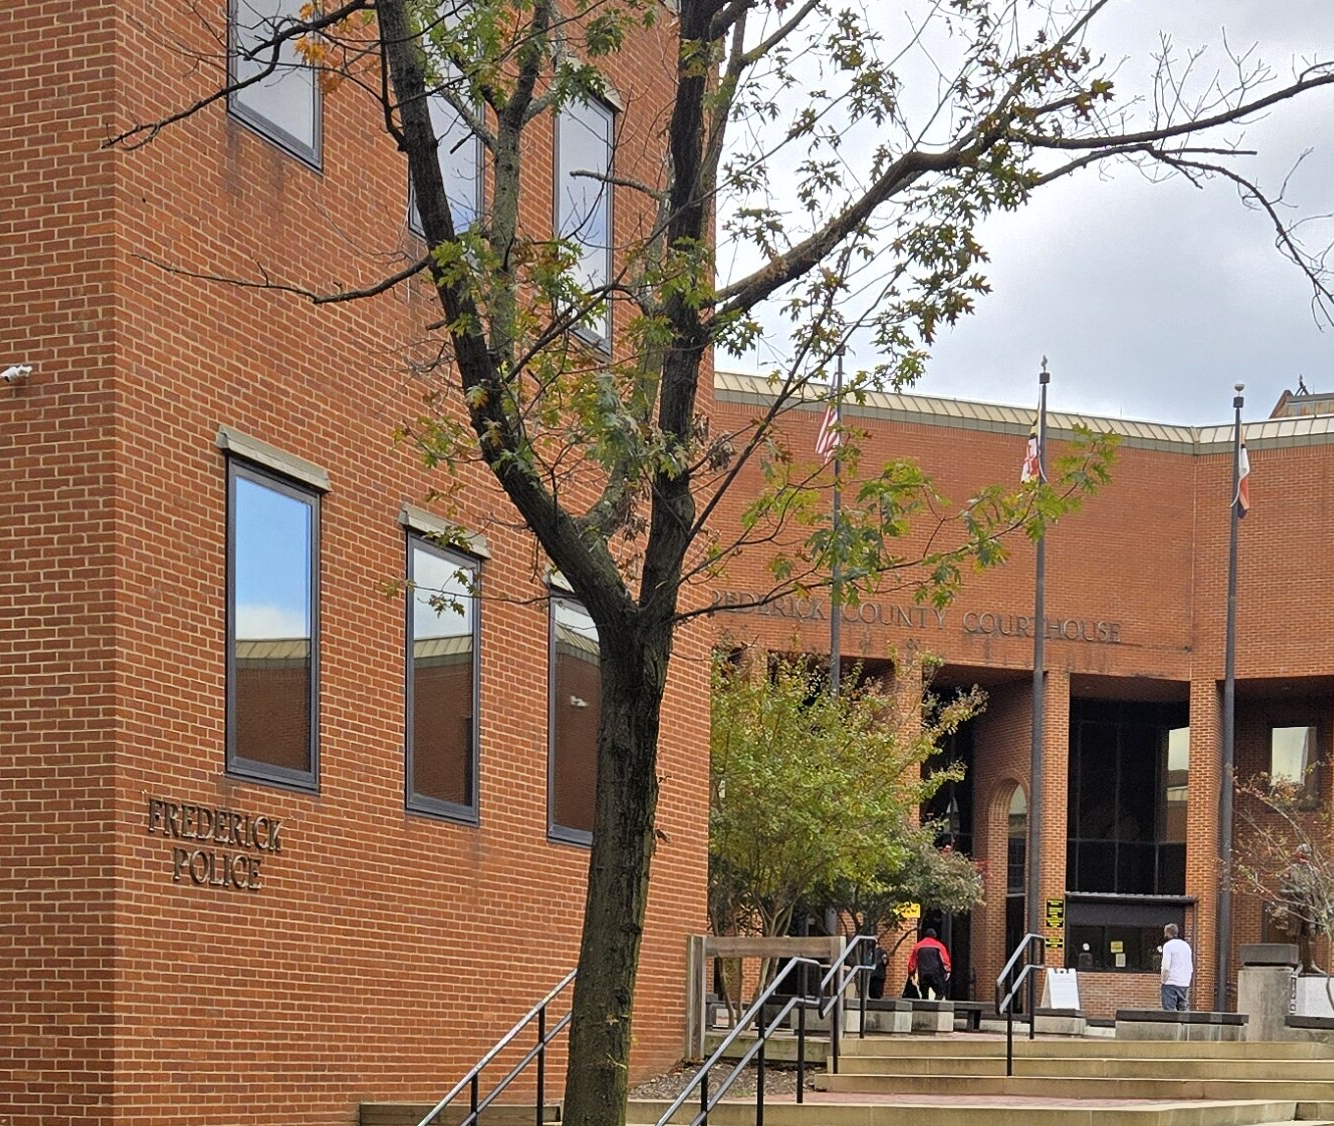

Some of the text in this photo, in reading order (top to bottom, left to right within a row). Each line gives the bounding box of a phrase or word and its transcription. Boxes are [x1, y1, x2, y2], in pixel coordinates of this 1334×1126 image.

[840, 601, 948, 629] COUNTY
[962, 611, 1122, 643] COURHOUSE
[148, 797, 283, 851] FREDERICK
[173, 847, 262, 891] POLICE
